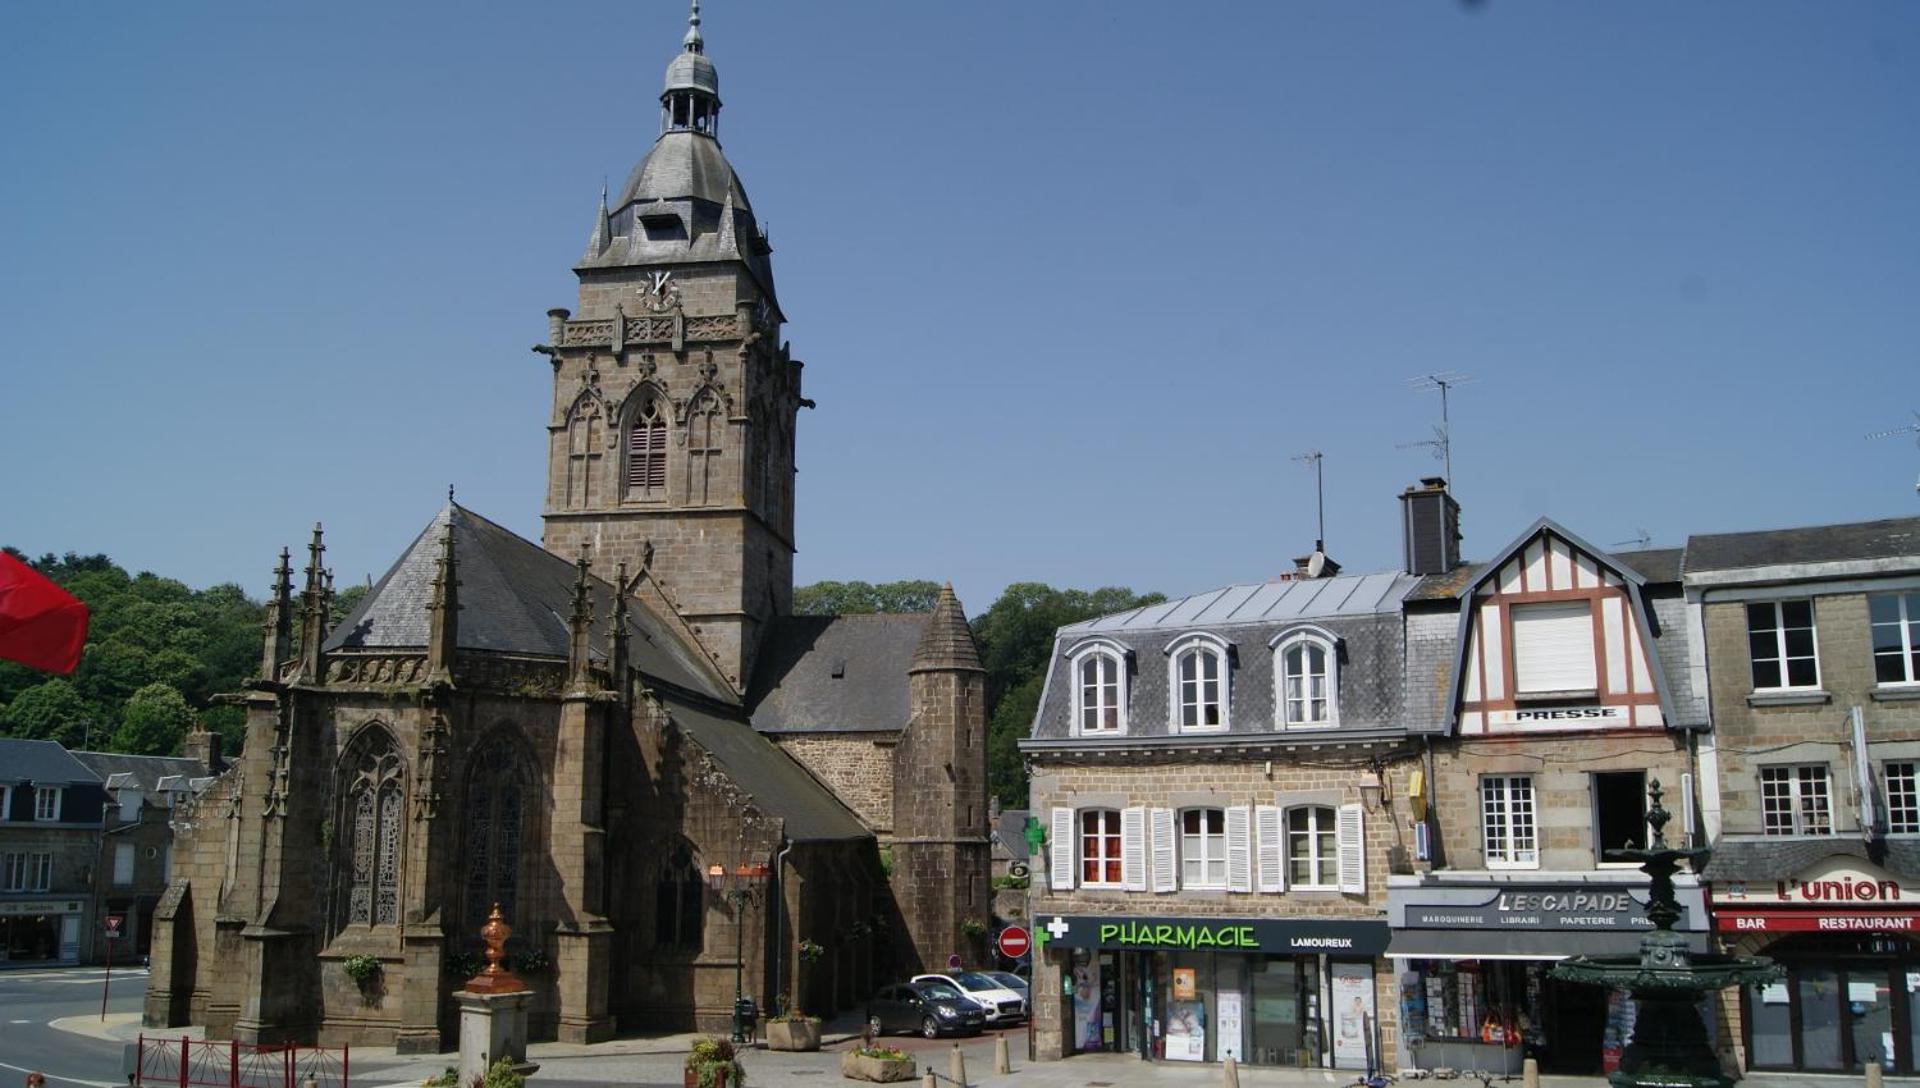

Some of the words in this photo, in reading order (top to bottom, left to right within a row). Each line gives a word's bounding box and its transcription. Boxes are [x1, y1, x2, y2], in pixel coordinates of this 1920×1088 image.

[1516, 708, 1616, 720] PRESSE
[1498, 894, 1629, 912] L'ESCAPADE
[1422, 915, 1484, 924] MAROQUINERIE
[1560, 917, 1616, 925] PAPETERIE
[1736, 918, 1767, 929] BAR
[1819, 918, 1913, 929] RESTAURANT
[1101, 920, 1259, 949] PHARMACIE
[1290, 938, 1353, 948] LAMOUREUX
